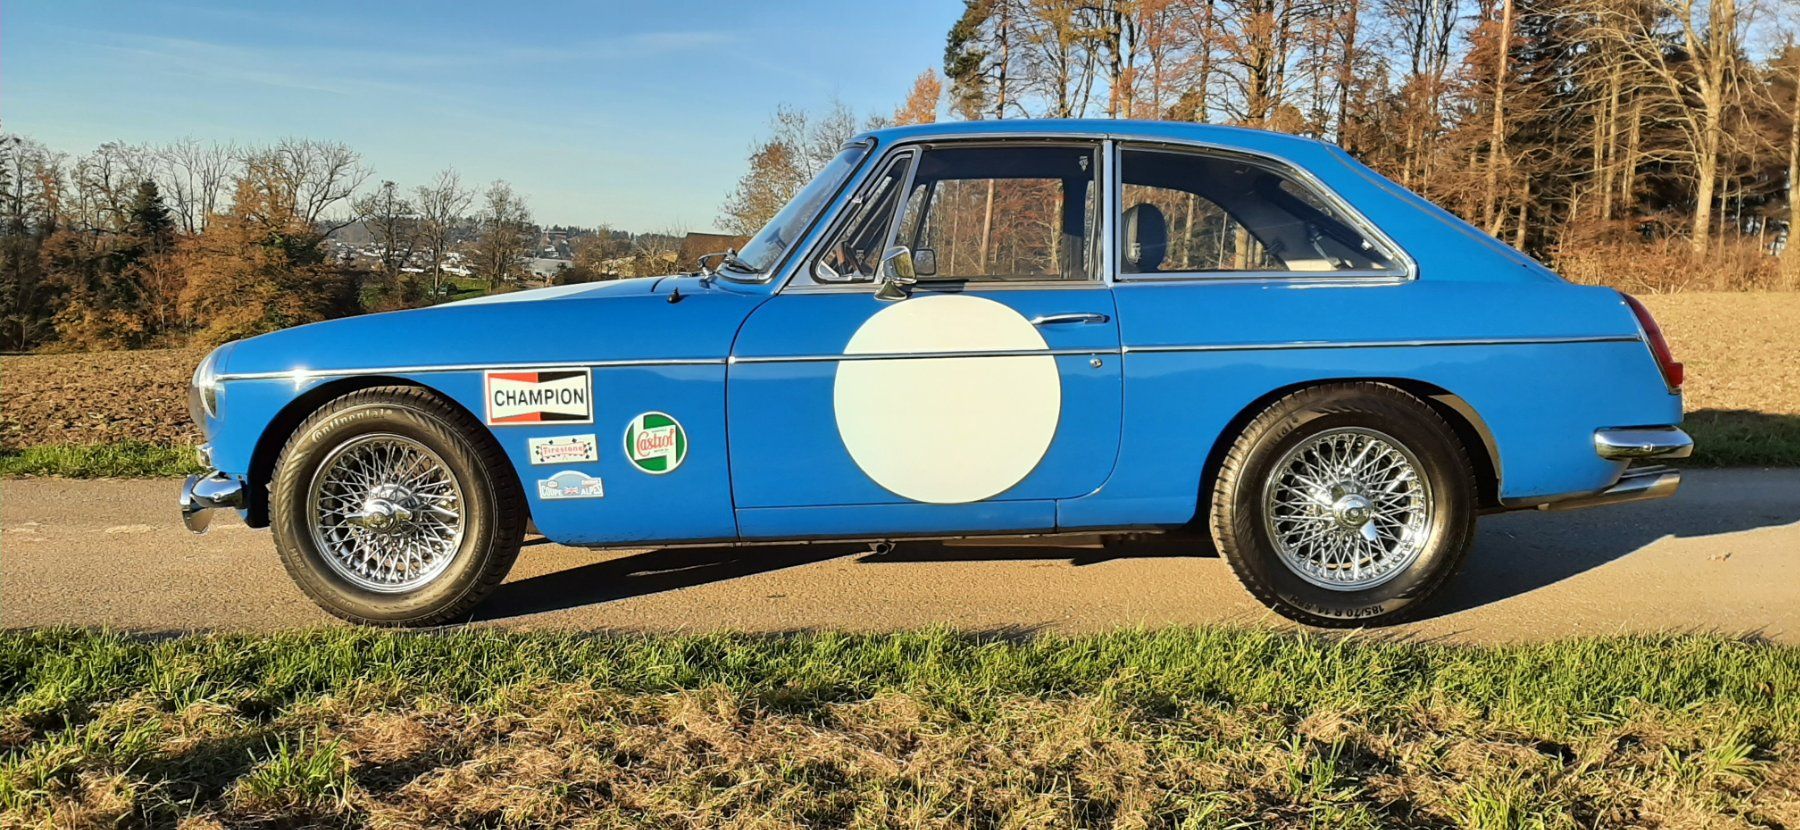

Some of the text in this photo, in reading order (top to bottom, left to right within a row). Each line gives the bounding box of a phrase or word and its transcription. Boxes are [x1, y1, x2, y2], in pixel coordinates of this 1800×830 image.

[494, 388, 584, 407] CHAMPION
[636, 428, 675, 457] Castrol
[543, 445, 586, 455] Firestone
[1334, 608, 1342, 617] R
[1346, 604, 1384, 617] 185/70
